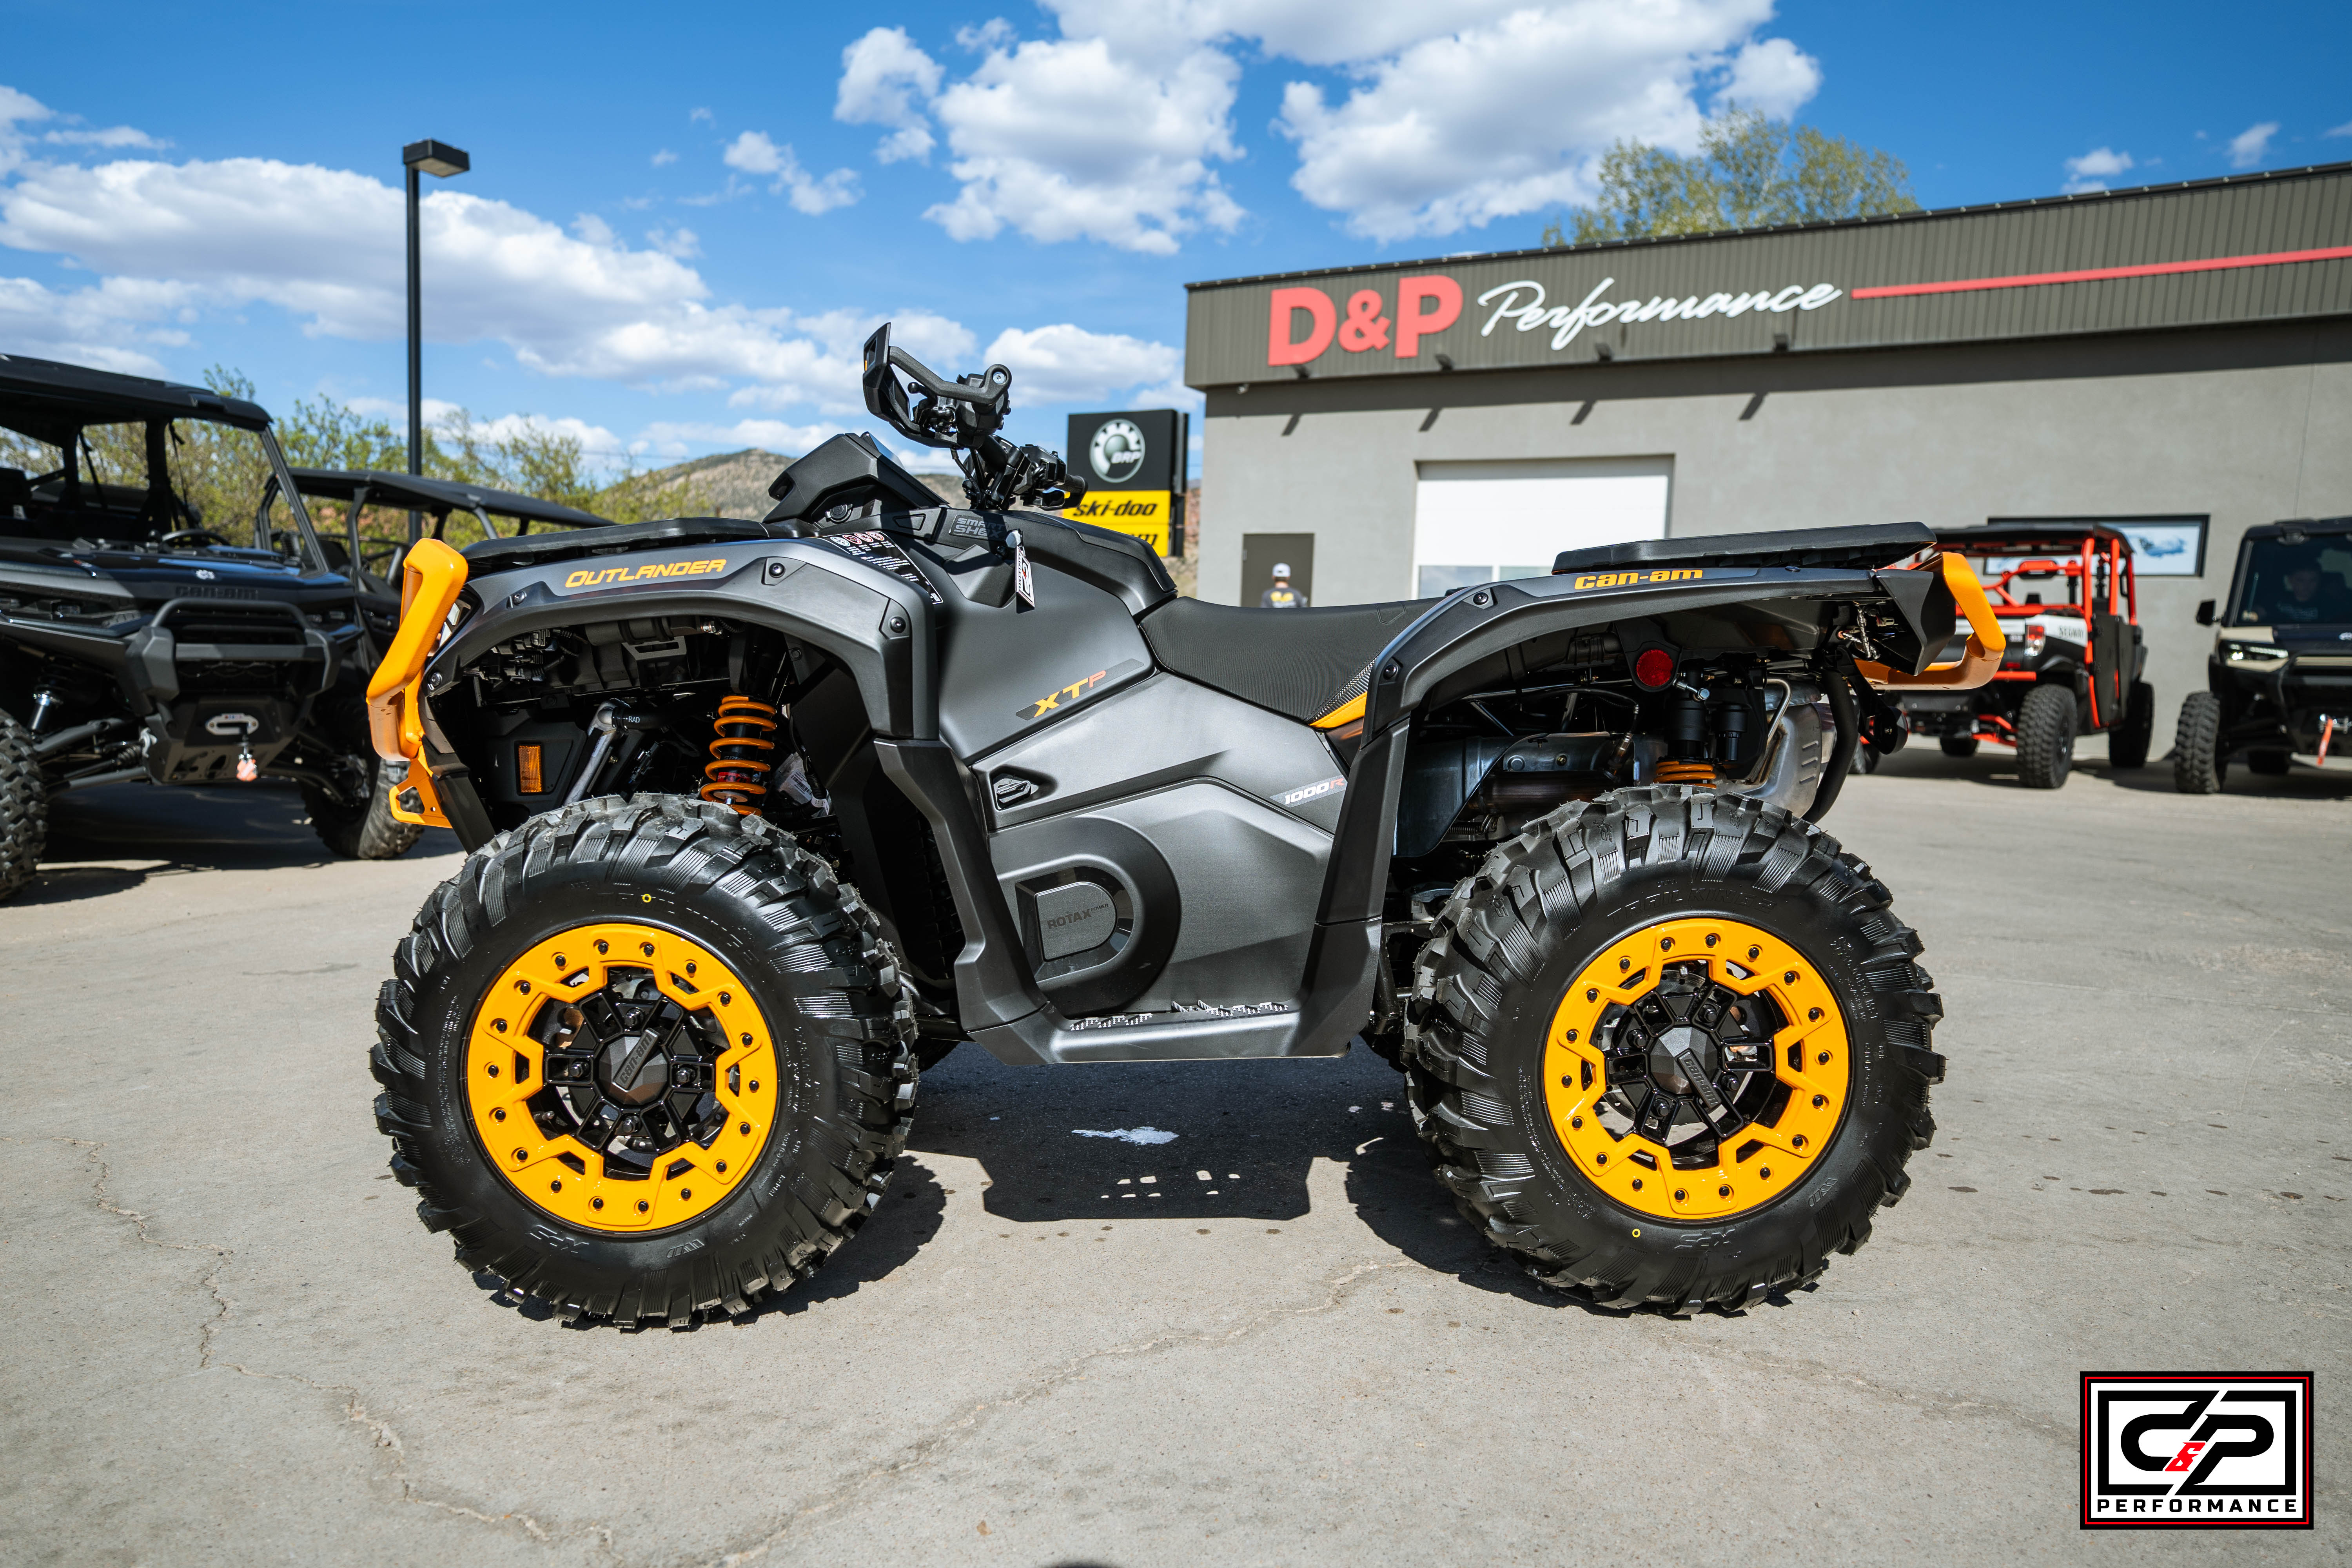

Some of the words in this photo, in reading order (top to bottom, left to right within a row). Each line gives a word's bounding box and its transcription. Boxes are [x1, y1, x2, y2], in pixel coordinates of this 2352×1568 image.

[1268, 274, 1464, 367] D&P
[1477, 276, 1843, 351] Performance
[1111, 452, 1141, 464] BRP
[1073, 500, 1158, 516] ski-doo
[957, 517, 1005, 529] SMART
[565, 559, 727, 588] OUTLANDER
[1574, 570, 1703, 590] can-am
[2058, 627, 2084, 638] SEGWAY
[1034, 670, 1106, 717] XTP
[1285, 778, 1345, 804] 1000R
[1091, 903, 1109, 912] POWER
[1607, 889, 1683, 925] TRAIL
[1047, 909, 1092, 929] ROTAX
[619, 1033, 653, 1084] can-am
[1683, 1059, 1719, 1105] can-am
